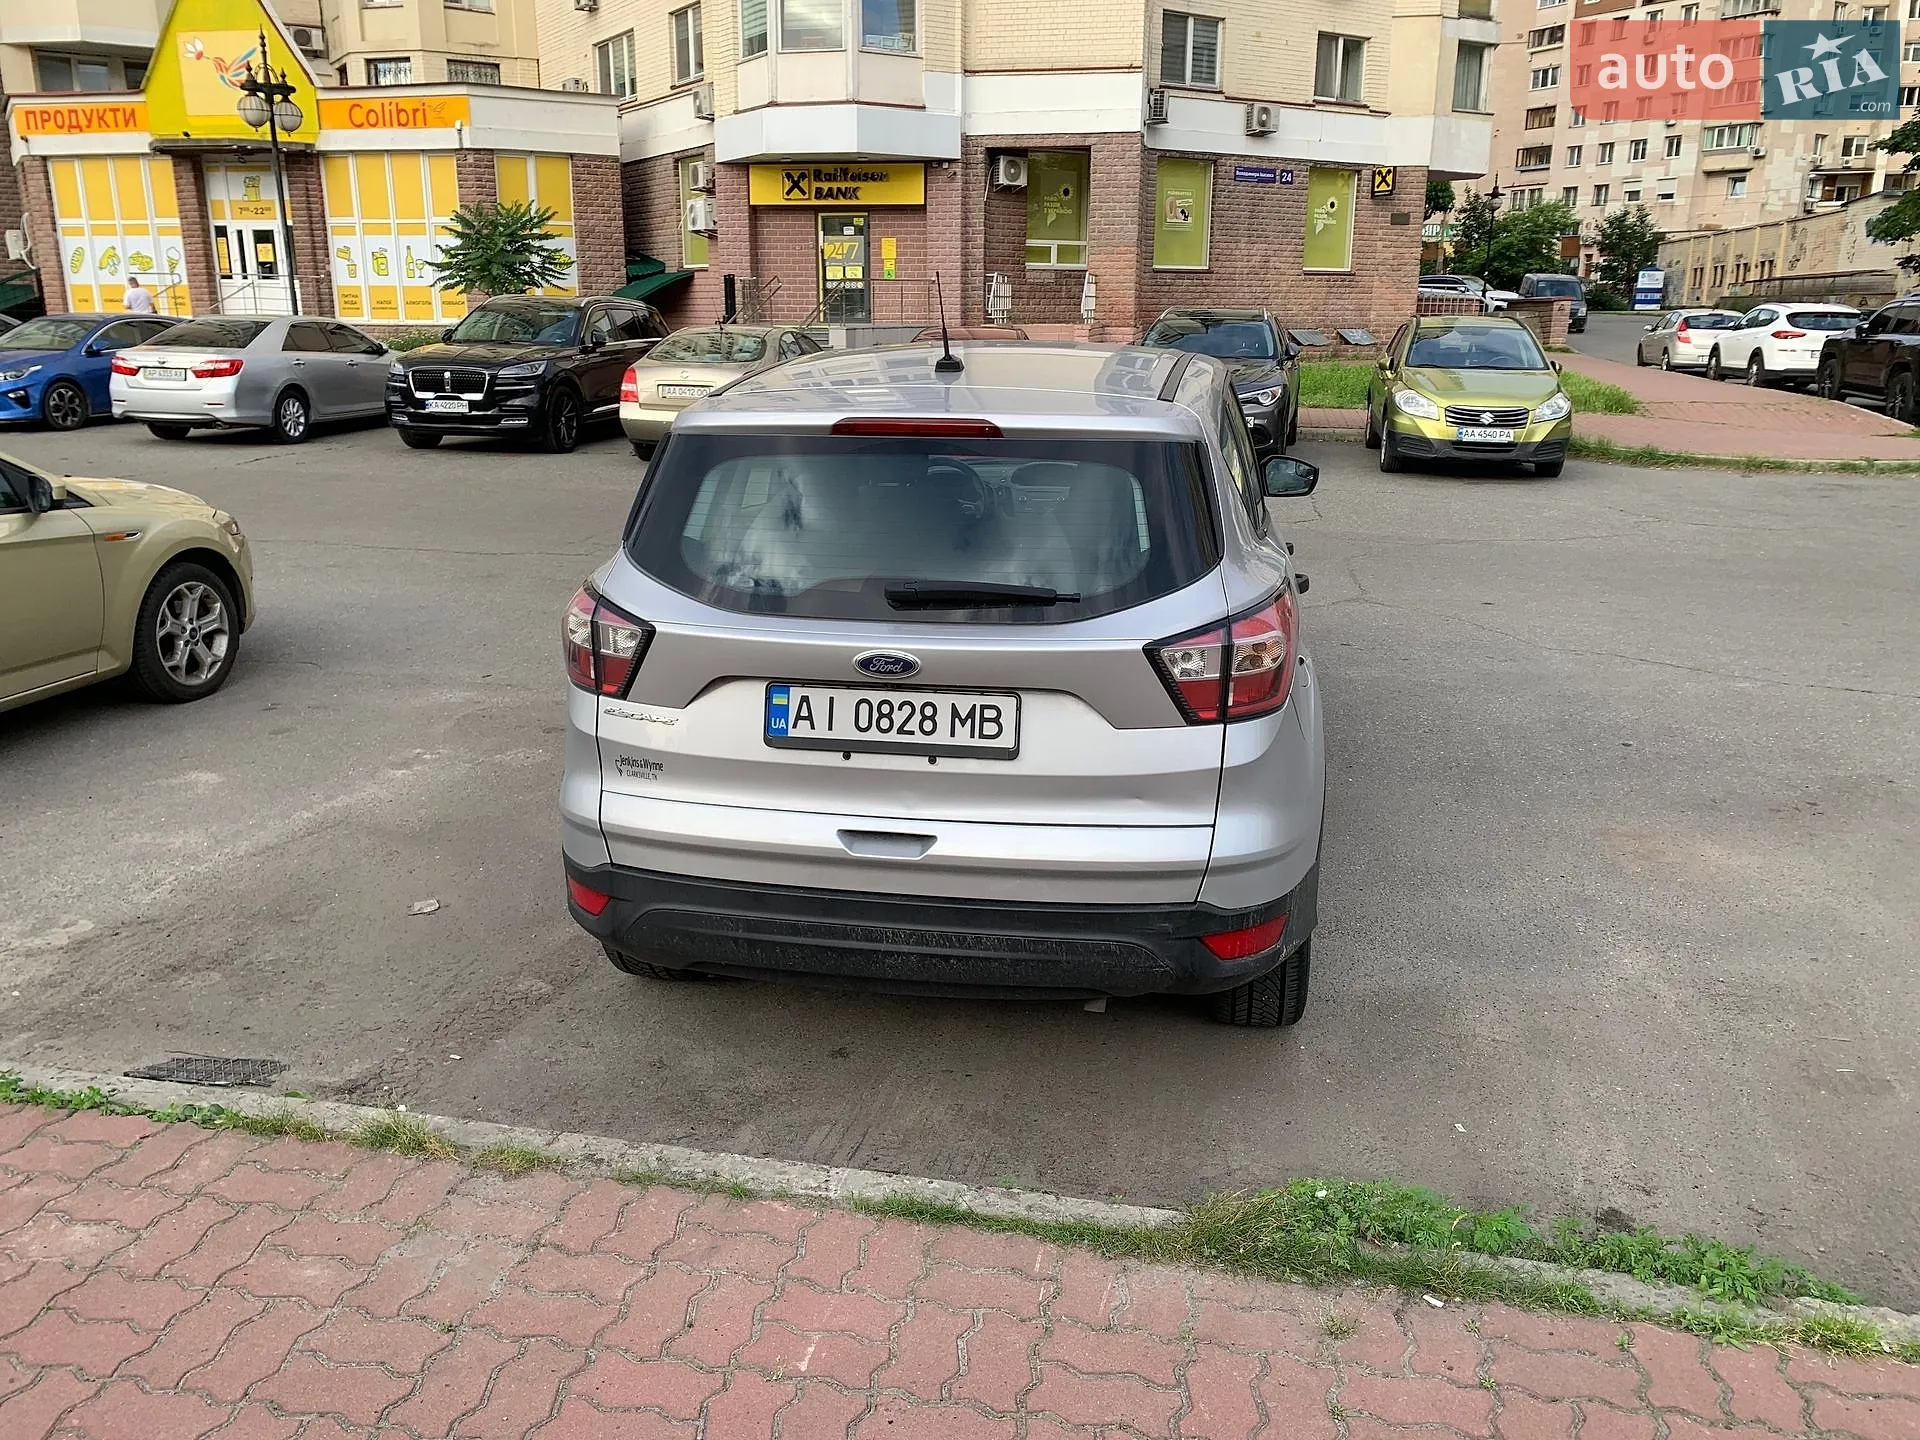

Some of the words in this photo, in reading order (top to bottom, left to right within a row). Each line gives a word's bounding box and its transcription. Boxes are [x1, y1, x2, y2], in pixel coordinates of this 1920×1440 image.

[25, 107, 137, 133] ПРОДУКТИ
[1282, 172, 1292, 182] 24
[813, 186, 862, 200] BANK
[1463, 429, 1476, 438] AA
[1478, 430, 1498, 439] 4540
[1499, 431, 1511, 439] PA
[869, 657, 904, 672] Ford
[771, 718, 786, 729] UA
[854, 698, 938, 736] 0828
[950, 703, 1003, 740] MB
